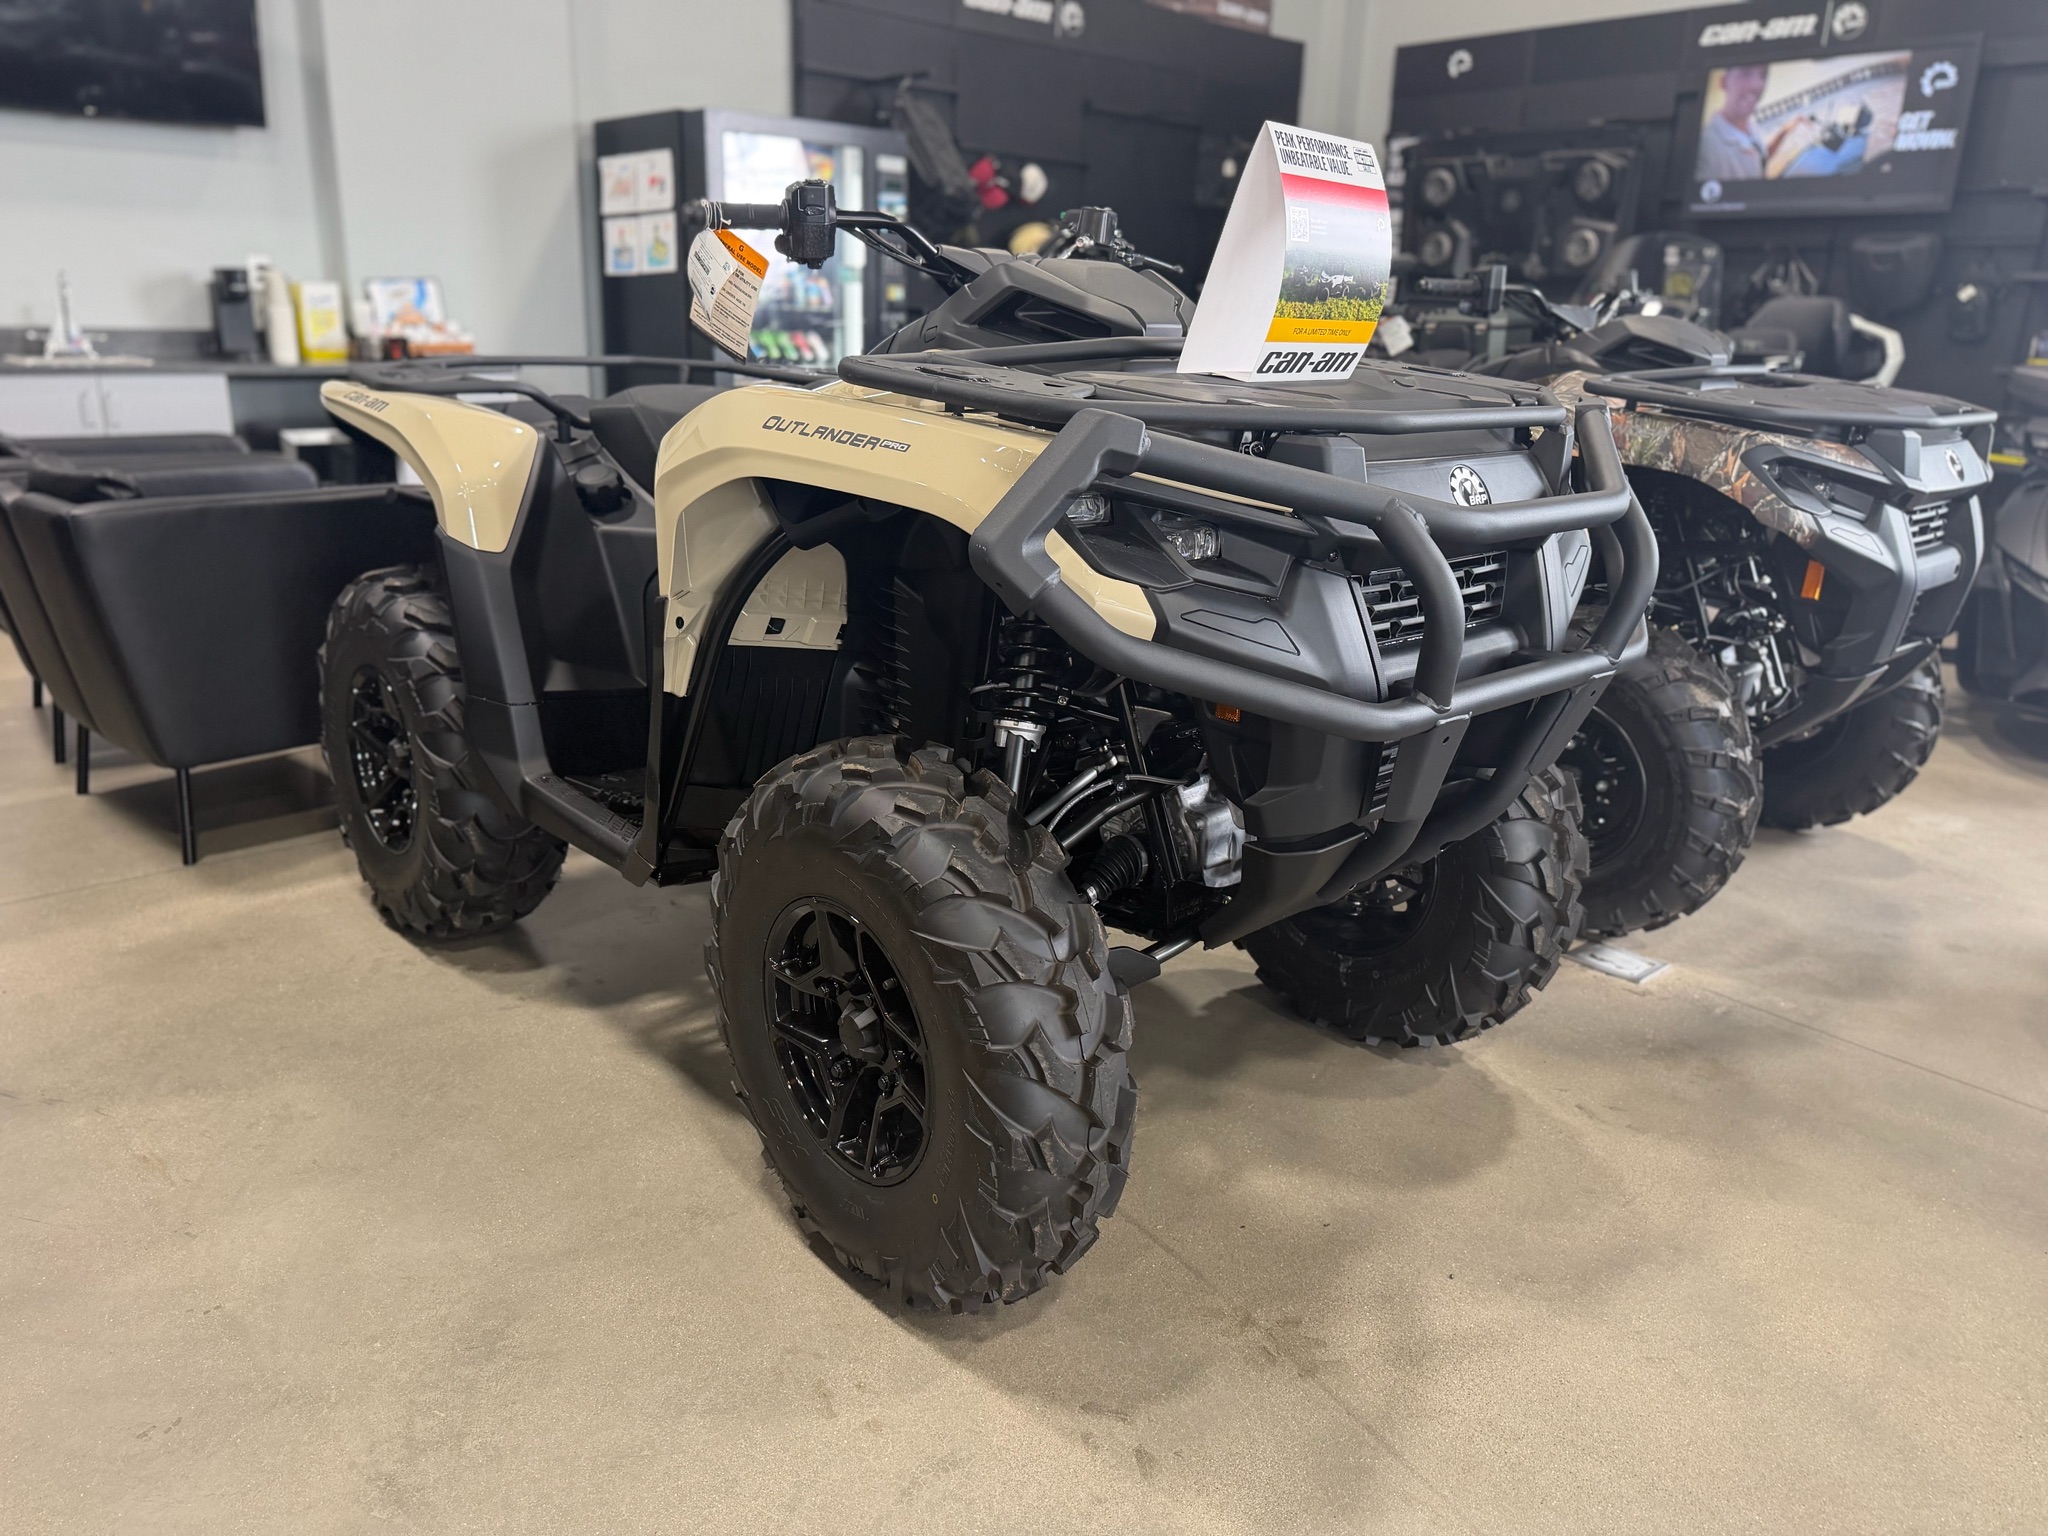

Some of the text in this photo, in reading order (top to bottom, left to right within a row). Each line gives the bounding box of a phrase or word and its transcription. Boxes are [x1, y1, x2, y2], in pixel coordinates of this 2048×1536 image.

[1274, 130, 1353, 160] PEAK PERFORMANCE.
[1279, 148, 1328, 172] UNBEATABLE
[1327, 157, 1353, 176] VALUE.
[738, 244, 745, 252] G
[736, 253, 746, 263] USE
[746, 260, 763, 275] MODEL
[1307, 328, 1328, 336] LIMITED
[1327, 328, 1339, 336] TIME
[1256, 351, 1358, 374] can-am
[343, 391, 390, 413] can-am
[762, 415, 909, 452] OUTLANDER PRO
[1469, 494, 1487, 506] BRP
